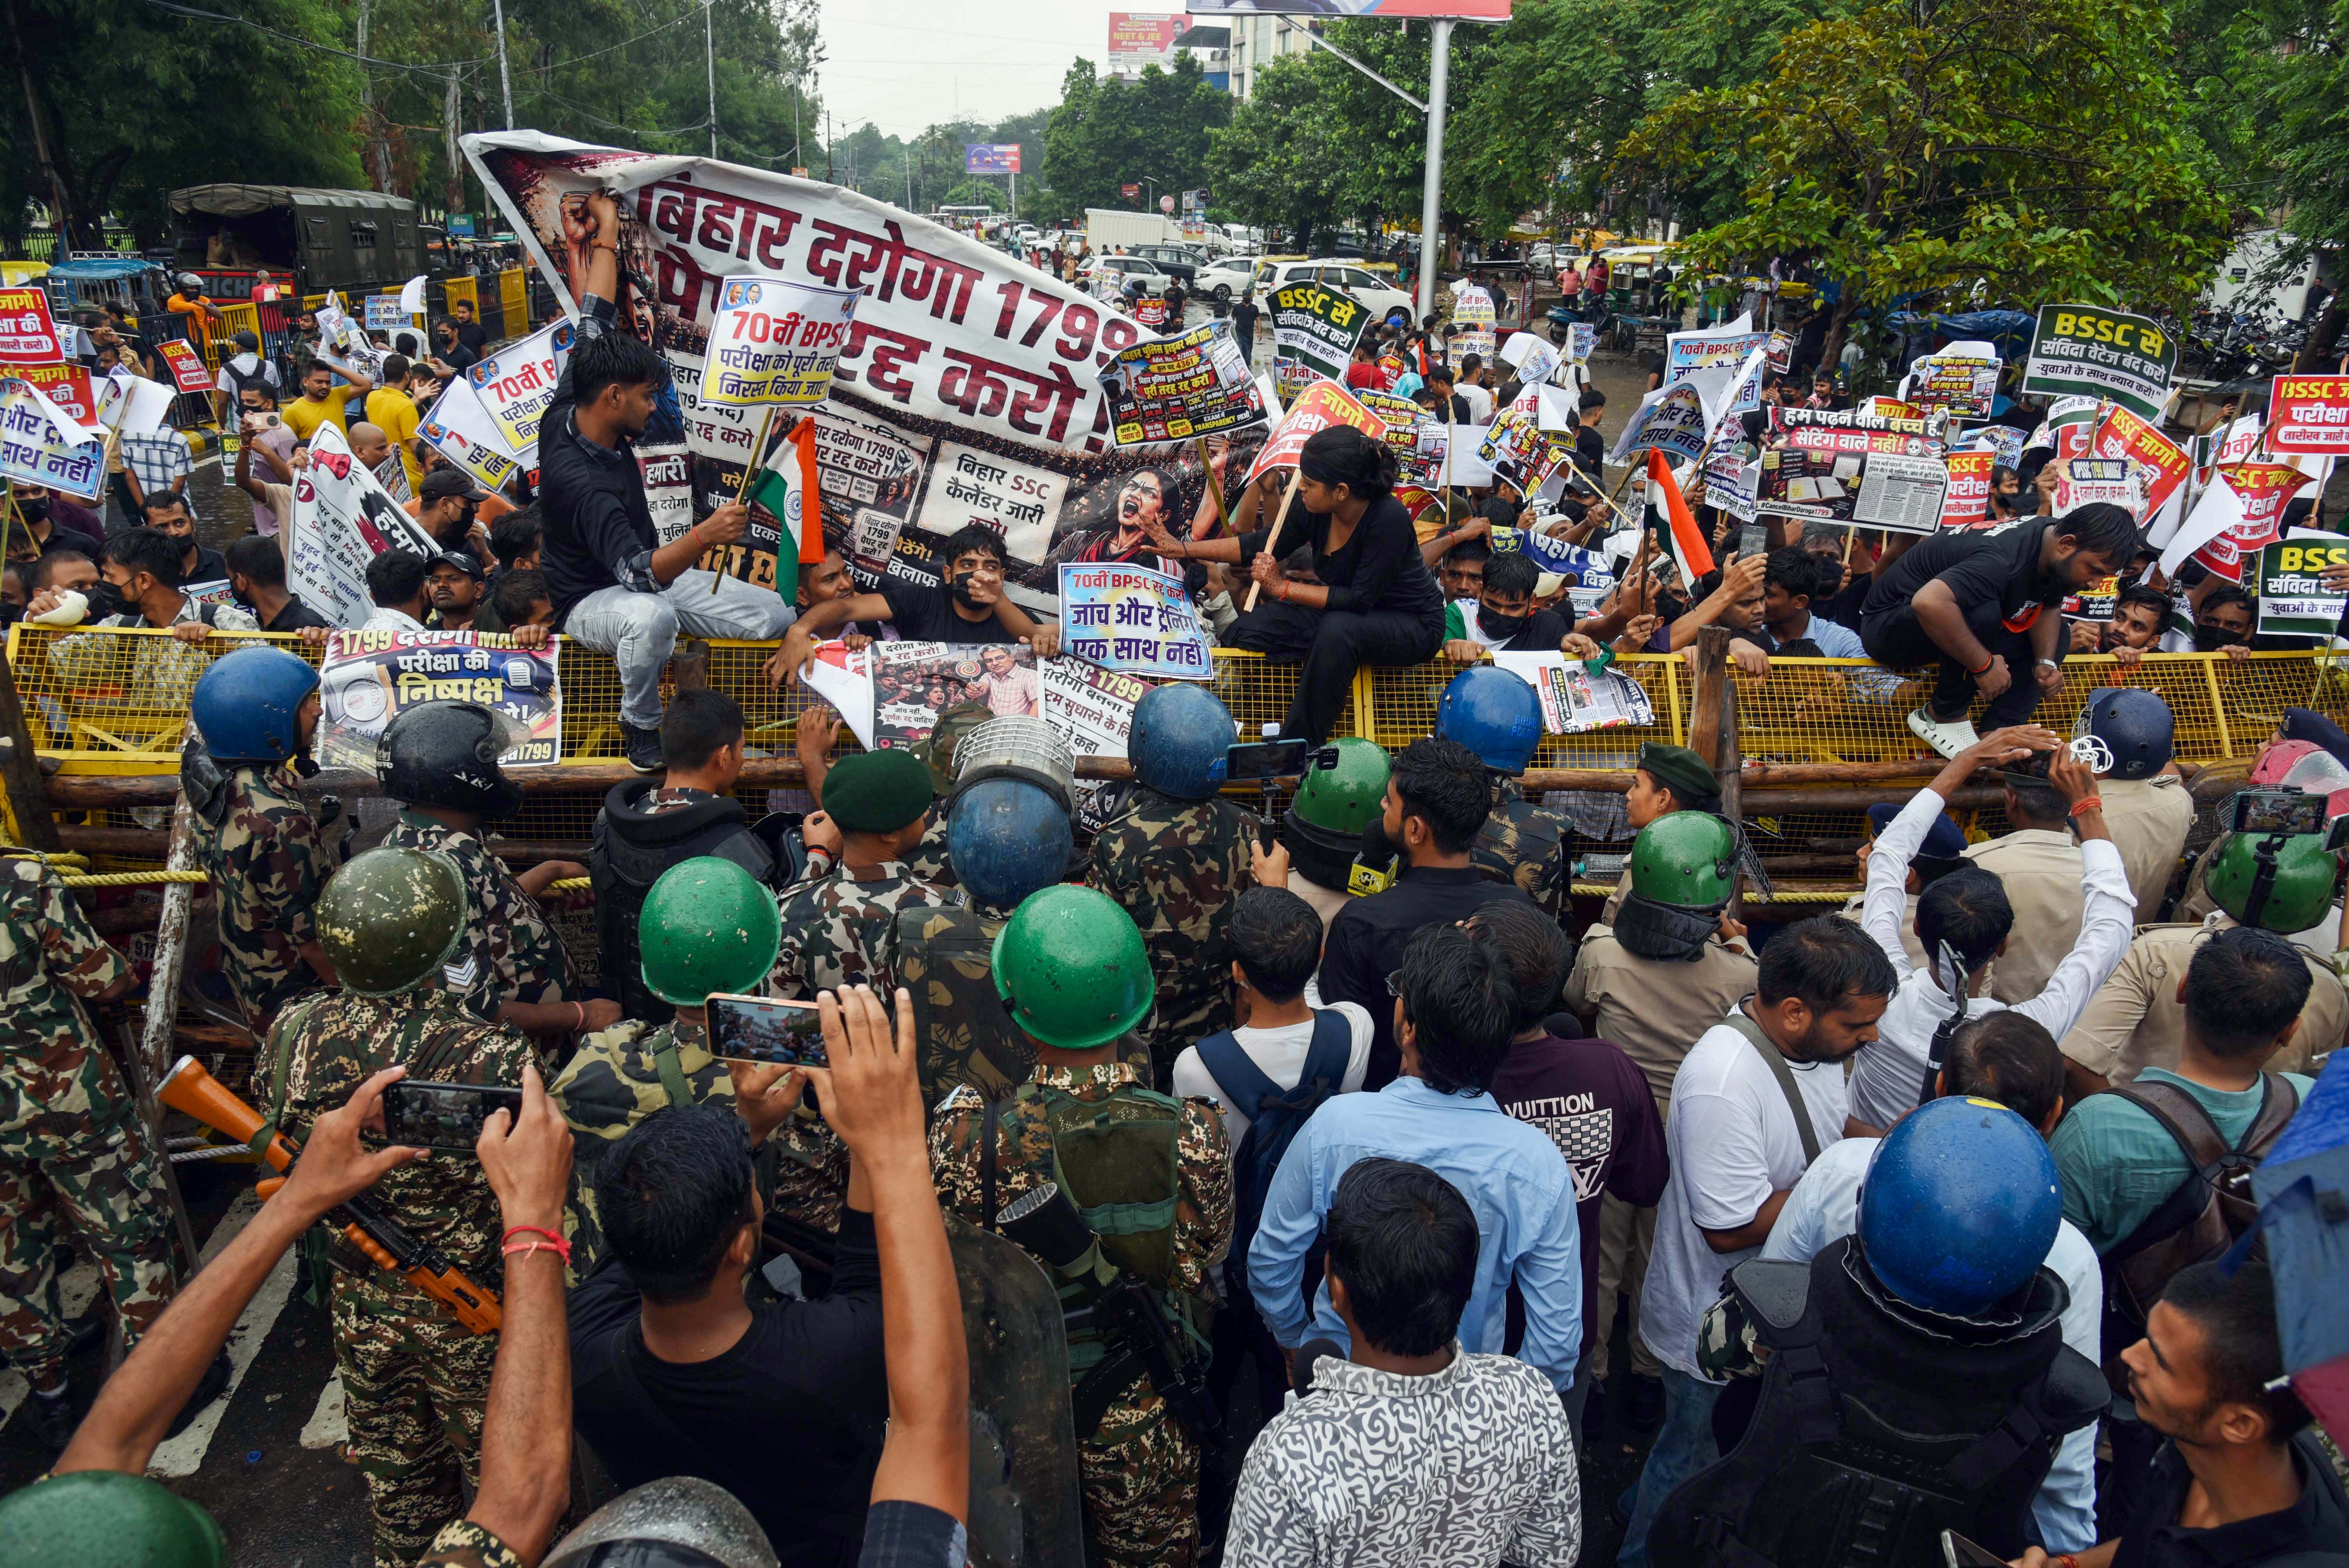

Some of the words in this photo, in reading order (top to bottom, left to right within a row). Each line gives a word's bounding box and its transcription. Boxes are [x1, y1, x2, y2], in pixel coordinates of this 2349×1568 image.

[637, 171, 802, 271] बिहार
[807, 217, 985, 325] दरोगा
[994, 280, 1137, 369] 1799
[200, 279, 278, 296] EICH
[383, 306, 394, 314] और
[1278, 288, 1330, 314] BSSC
[1330, 301, 1357, 327] से
[18, 313, 42, 333] की
[732, 310, 805, 347] 70वीं
[1119, 351, 1142, 362] बिहार
[1141, 344, 1162, 358] पुलिस
[1197, 326, 1212, 342] 2025
[1328, 328, 1353, 348] करो
[2054, 313, 2135, 347] BSSC
[2139, 327, 2165, 358] से
[1176, 348, 1196, 360] 2/2025
[1466, 342, 1477, 351] और
[1679, 342, 1706, 355] 70वीं
[1706, 342, 1734, 355] BPSC
[1734, 342, 1745, 353] रद्द
[720, 345, 771, 372] परीक्षा
[772, 348, 791, 372] को
[792, 350, 817, 378] पूरी
[1176, 358, 1194, 369] 4361
[2041, 337, 2087, 358] संविदा
[2088, 342, 2121, 365] वेटेज
[2122, 351, 2143, 372] बंद
[2142, 360, 2166, 383] करो
[28, 364, 70, 383] जागो
[488, 362, 543, 403] 70वीं
[1138, 375, 1151, 385] बिहार
[2073, 365, 2085, 376] के
[2086, 369, 2108, 381] साथ
[2110, 374, 2135, 389] न्याय
[718, 371, 768, 399] निरस्त
[768, 375, 803, 397] किया
[938, 347, 1087, 444] करो
[1143, 385, 1157, 400] पूरी
[1158, 383, 1177, 396] तरह
[1178, 379, 1191, 392] रद्द
[1191, 374, 1209, 388] करो
[2281, 382, 2334, 399] BSSC
[500, 397, 541, 422] परीक्षा
[1119, 403, 1135, 412] CBSE
[1188, 397, 1202, 406] CSBC
[1360, 392, 1374, 406] बिहार
[5, 404, 42, 436] और
[1194, 414, 1236, 431] TRANSPARENCY
[1236, 410, 1249, 422] लाओ
[1203, 413, 1221, 422] EXAM
[1654, 403, 1684, 422] और
[1784, 407, 1815, 426] हम
[2290, 402, 2349, 423] परीक्षा
[721, 426, 754, 449] करो
[831, 430, 864, 452] दरोगा
[866, 440, 896, 460] 1799
[1640, 428, 1675, 443] साथ
[1796, 428, 1836, 447] सेटिंग
[1839, 431, 1871, 451] वाले
[2111, 408, 2142, 442] BSSC
[2135, 431, 2179, 468] जागो
[2284, 429, 2319, 441] तारीख
[2323, 429, 2344, 441] जारी
[2, 440, 43, 471] साथ
[46, 456, 97, 485] नहीं
[646, 455, 686, 485] हमारी
[2073, 461, 2092, 479] BPSSC
[2090, 461, 2103, 479] 1799
[2102, 461, 2123, 479] DAROGA
[956, 453, 1007, 486] बिहार
[1011, 474, 1050, 501] SSC
[660, 497, 688, 510] दरोगा
[945, 476, 1004, 511] कैलेंडर
[1005, 500, 1046, 526] जारी
[2109, 486, 2117, 500] एक
[1761, 502, 1829, 516] #CancelBiharDaroga1799
[864, 516, 880, 526] बिहार
[880, 520, 896, 531] दरोगा
[867, 527, 890, 540] 1799
[861, 535, 876, 547] पेपर
[878, 541, 889, 550] रद्द
[1071, 570, 1110, 589] 70वीं
[1111, 573, 1151, 591] BPSC
[1166, 584, 1185, 602] करो
[2267, 574, 2318, 594] संविदा
[1069, 597, 1111, 626] जांच
[1115, 596, 1155, 626] और
[1157, 601, 1194, 633] ट्रेनिंग
[2307, 601, 2318, 613] के
[339, 630, 394, 656] 1799
[1071, 638, 1109, 662] एक
[1113, 638, 1161, 665] साथ
[1165, 636, 1203, 666] नहीं
[397, 650, 459, 673] परीक्षा
[463, 649, 492, 672] की
[396, 673, 506, 705] निष्पक्ष
[1096, 670, 1144, 702] 1799
[1074, 734, 1100, 754] कहा
